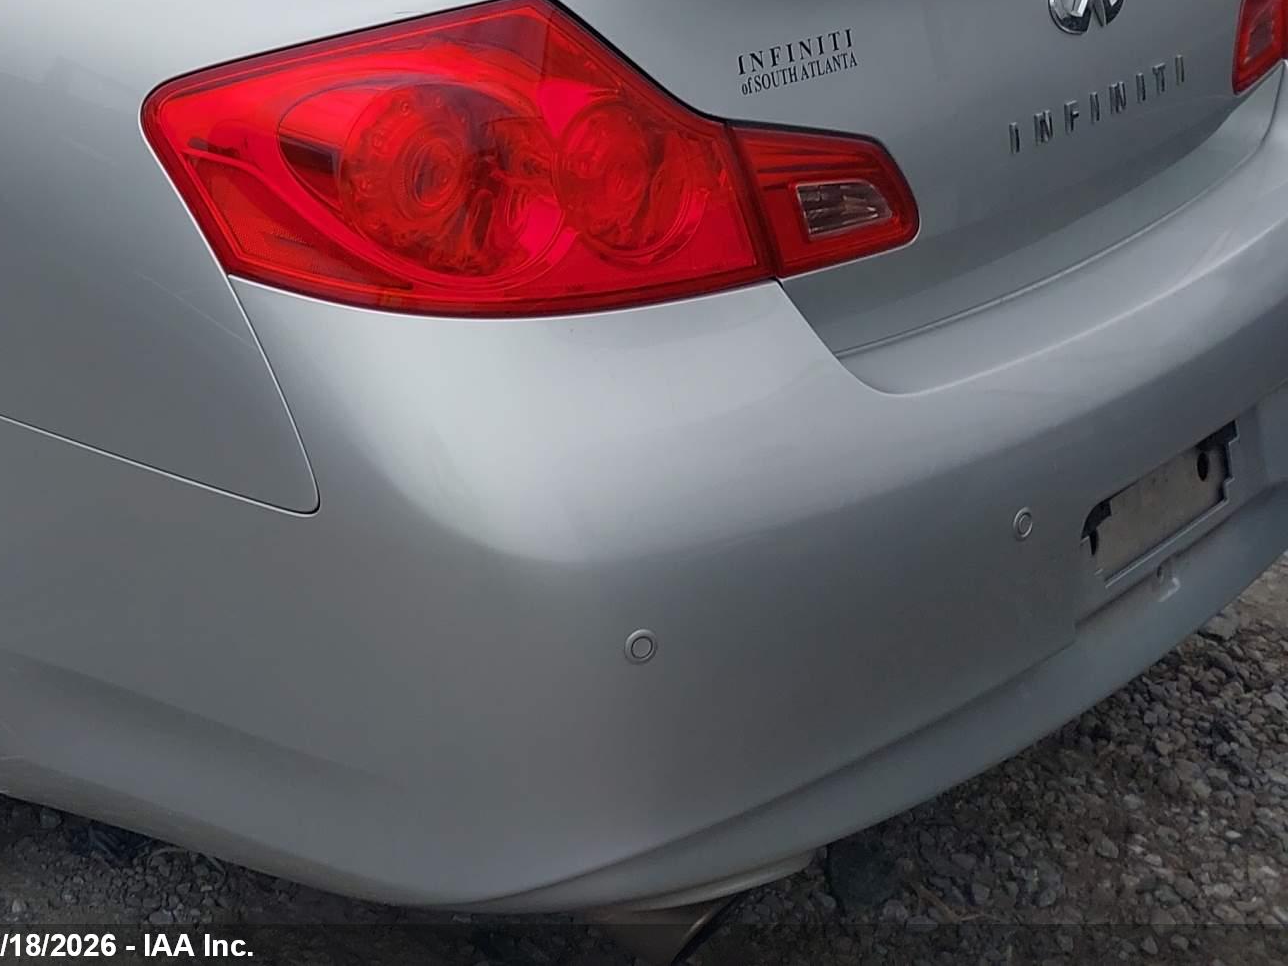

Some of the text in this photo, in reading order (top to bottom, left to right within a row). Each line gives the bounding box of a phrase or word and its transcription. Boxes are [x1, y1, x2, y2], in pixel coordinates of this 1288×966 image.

[737, 28, 853, 75] INFINITI
[753, 65, 798, 93] SOUTH
[800, 51, 858, 82] ATLANTA
[1009, 54, 1185, 154] INFINITI
